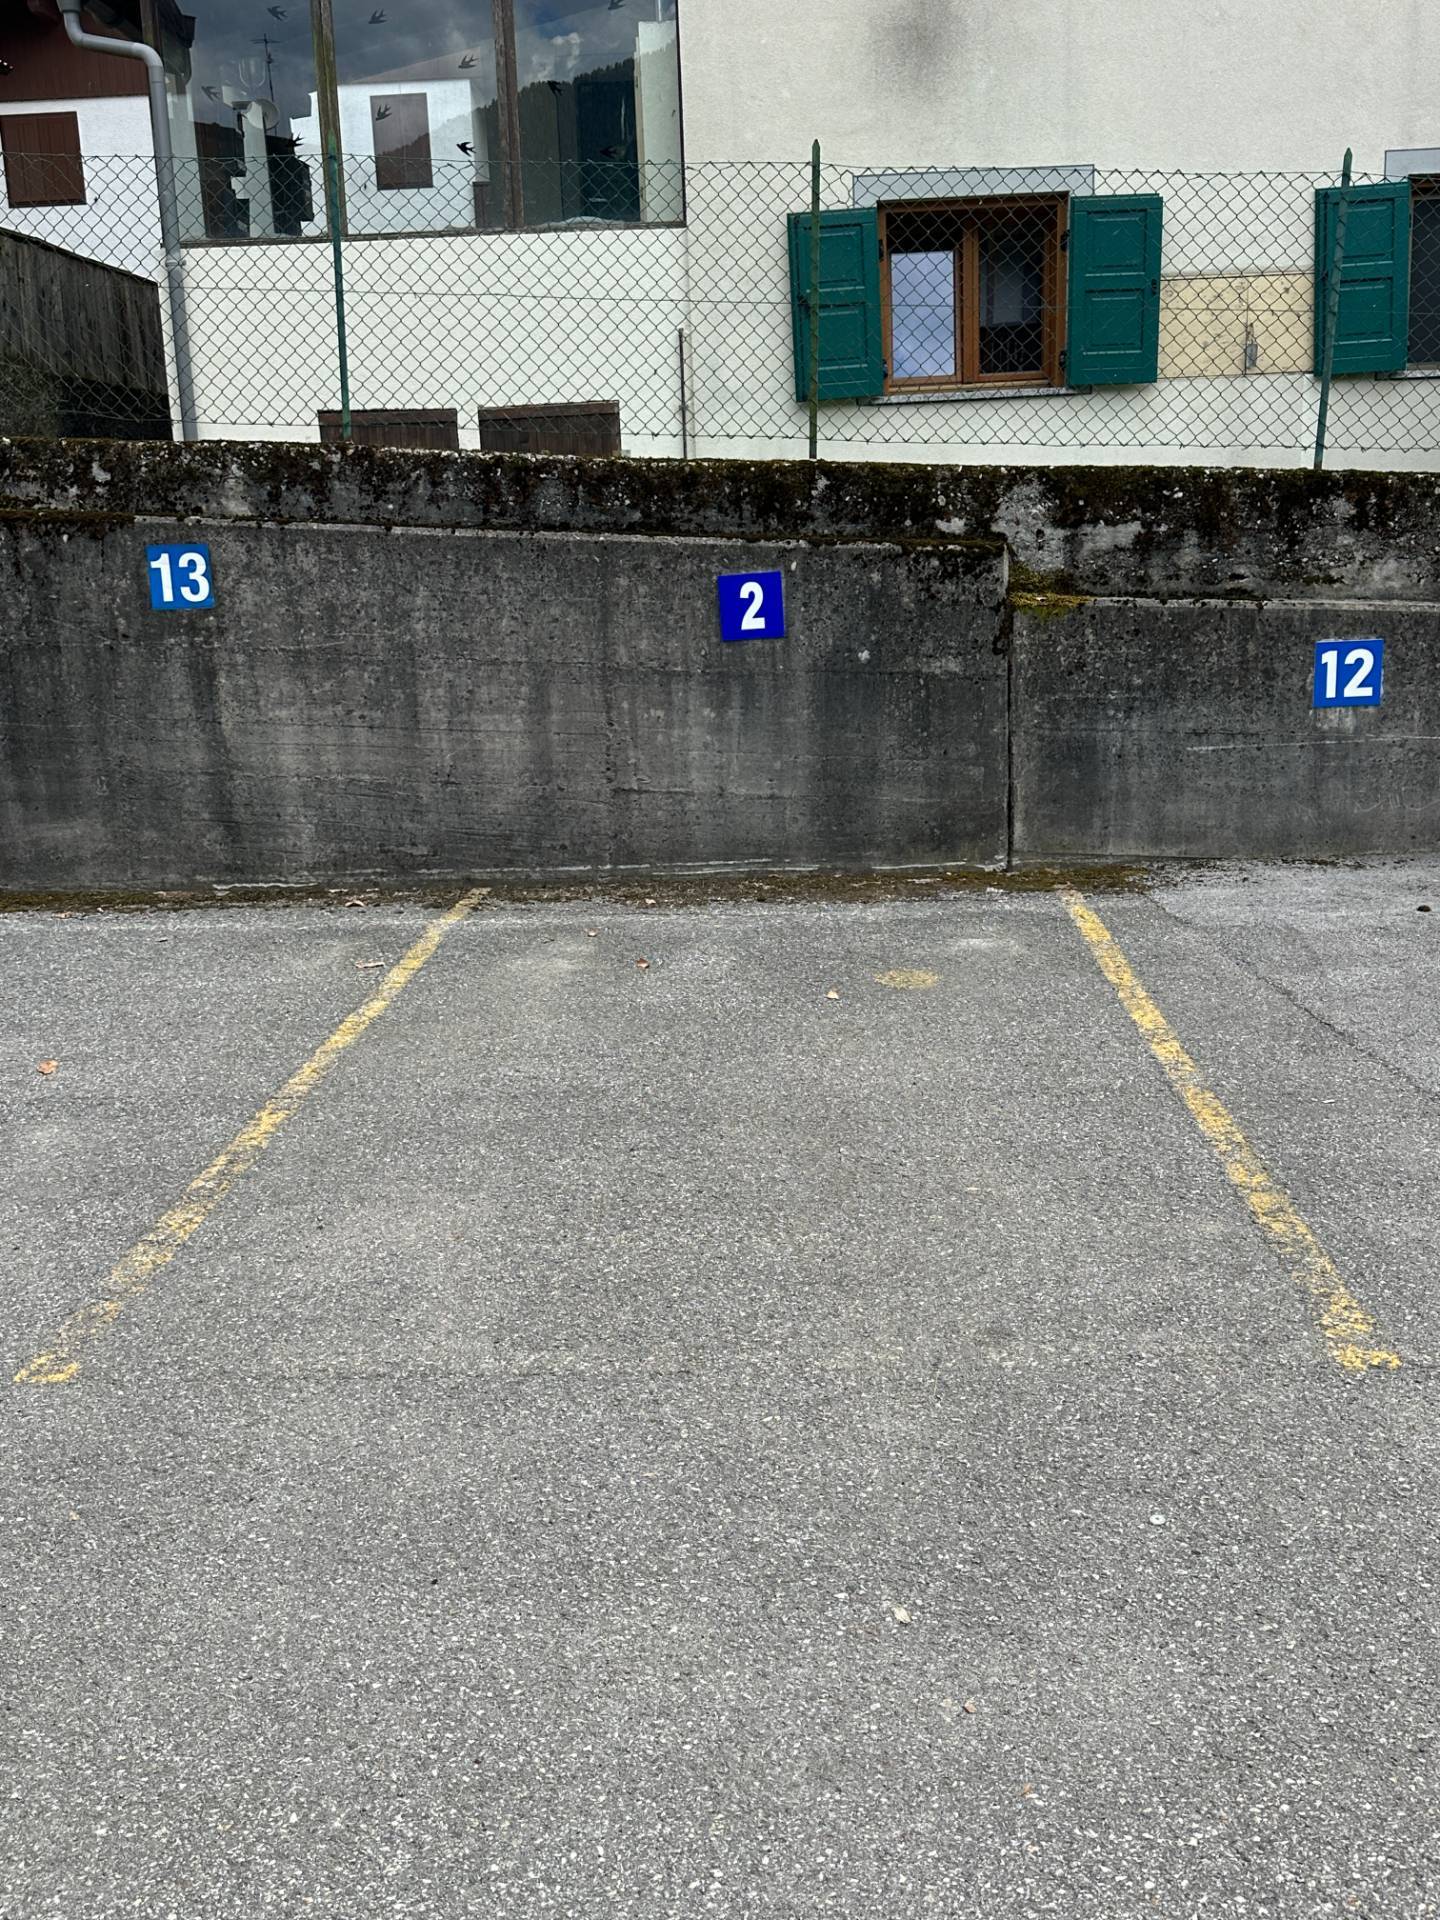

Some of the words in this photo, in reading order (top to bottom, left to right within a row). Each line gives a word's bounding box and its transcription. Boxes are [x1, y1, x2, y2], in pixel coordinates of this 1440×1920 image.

[150, 552, 210, 602] 13
[739, 581, 766, 630] 2
[1321, 648, 1374, 698] 12
